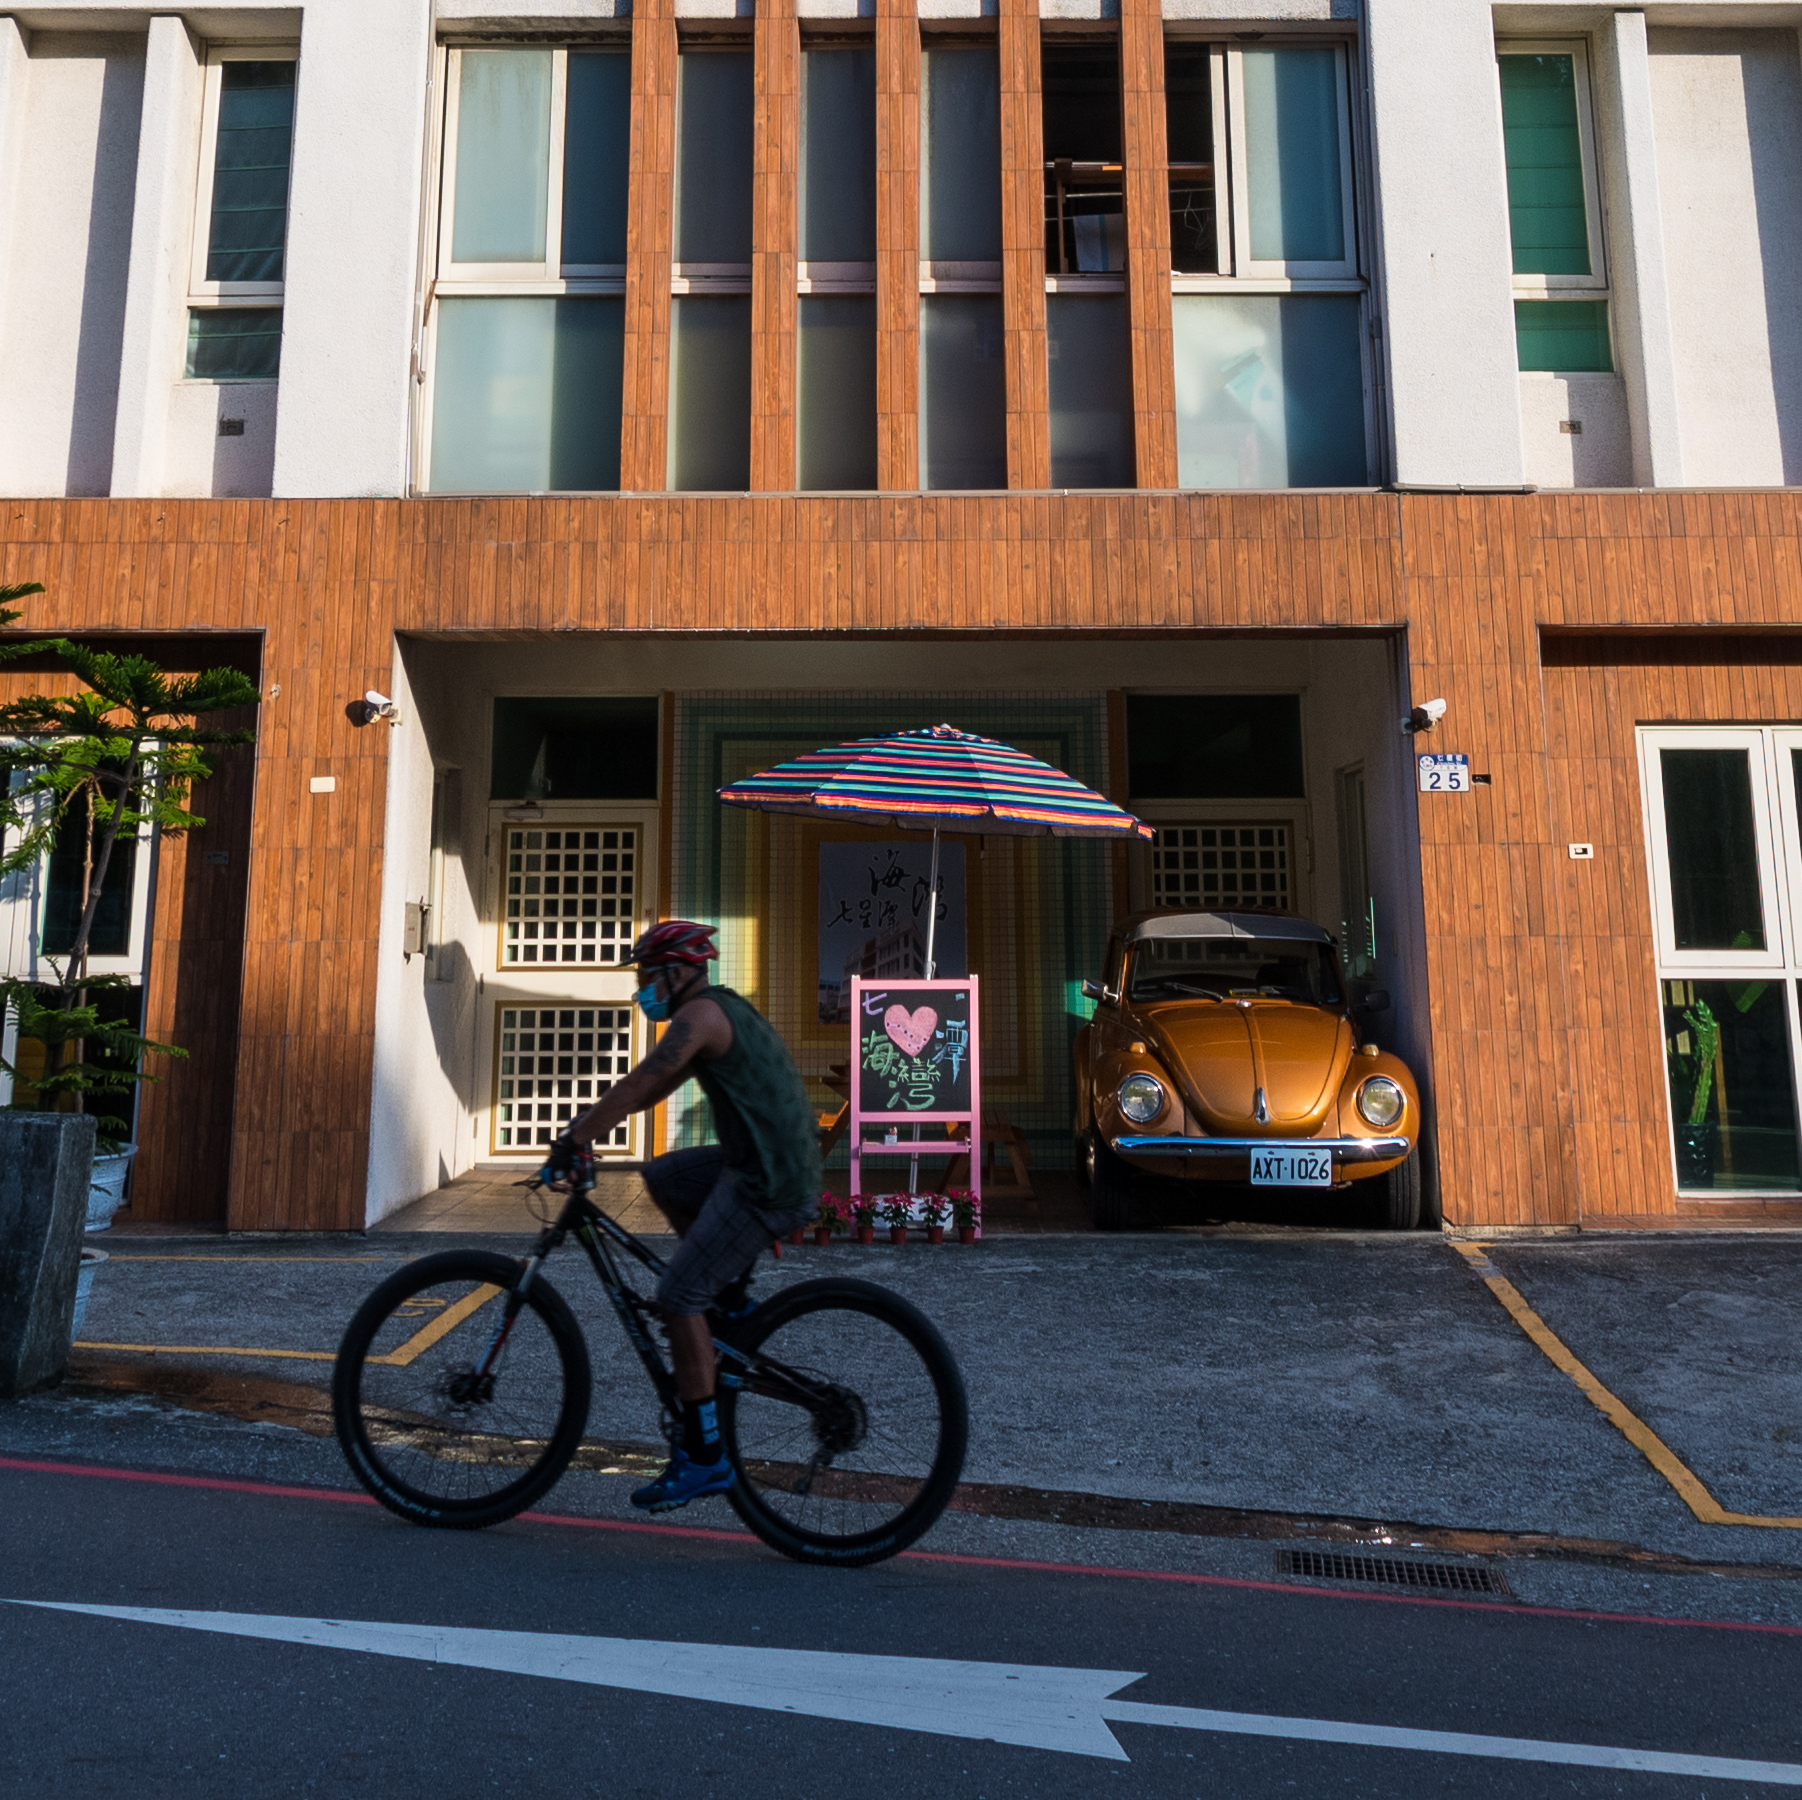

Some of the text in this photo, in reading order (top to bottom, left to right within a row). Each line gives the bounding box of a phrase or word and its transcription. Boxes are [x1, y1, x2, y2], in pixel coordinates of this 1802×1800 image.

[1428, 771, 1462, 790] 25
[861, 992, 969, 1085] 七 潭
[861, 1029, 941, 1111] 海灣
